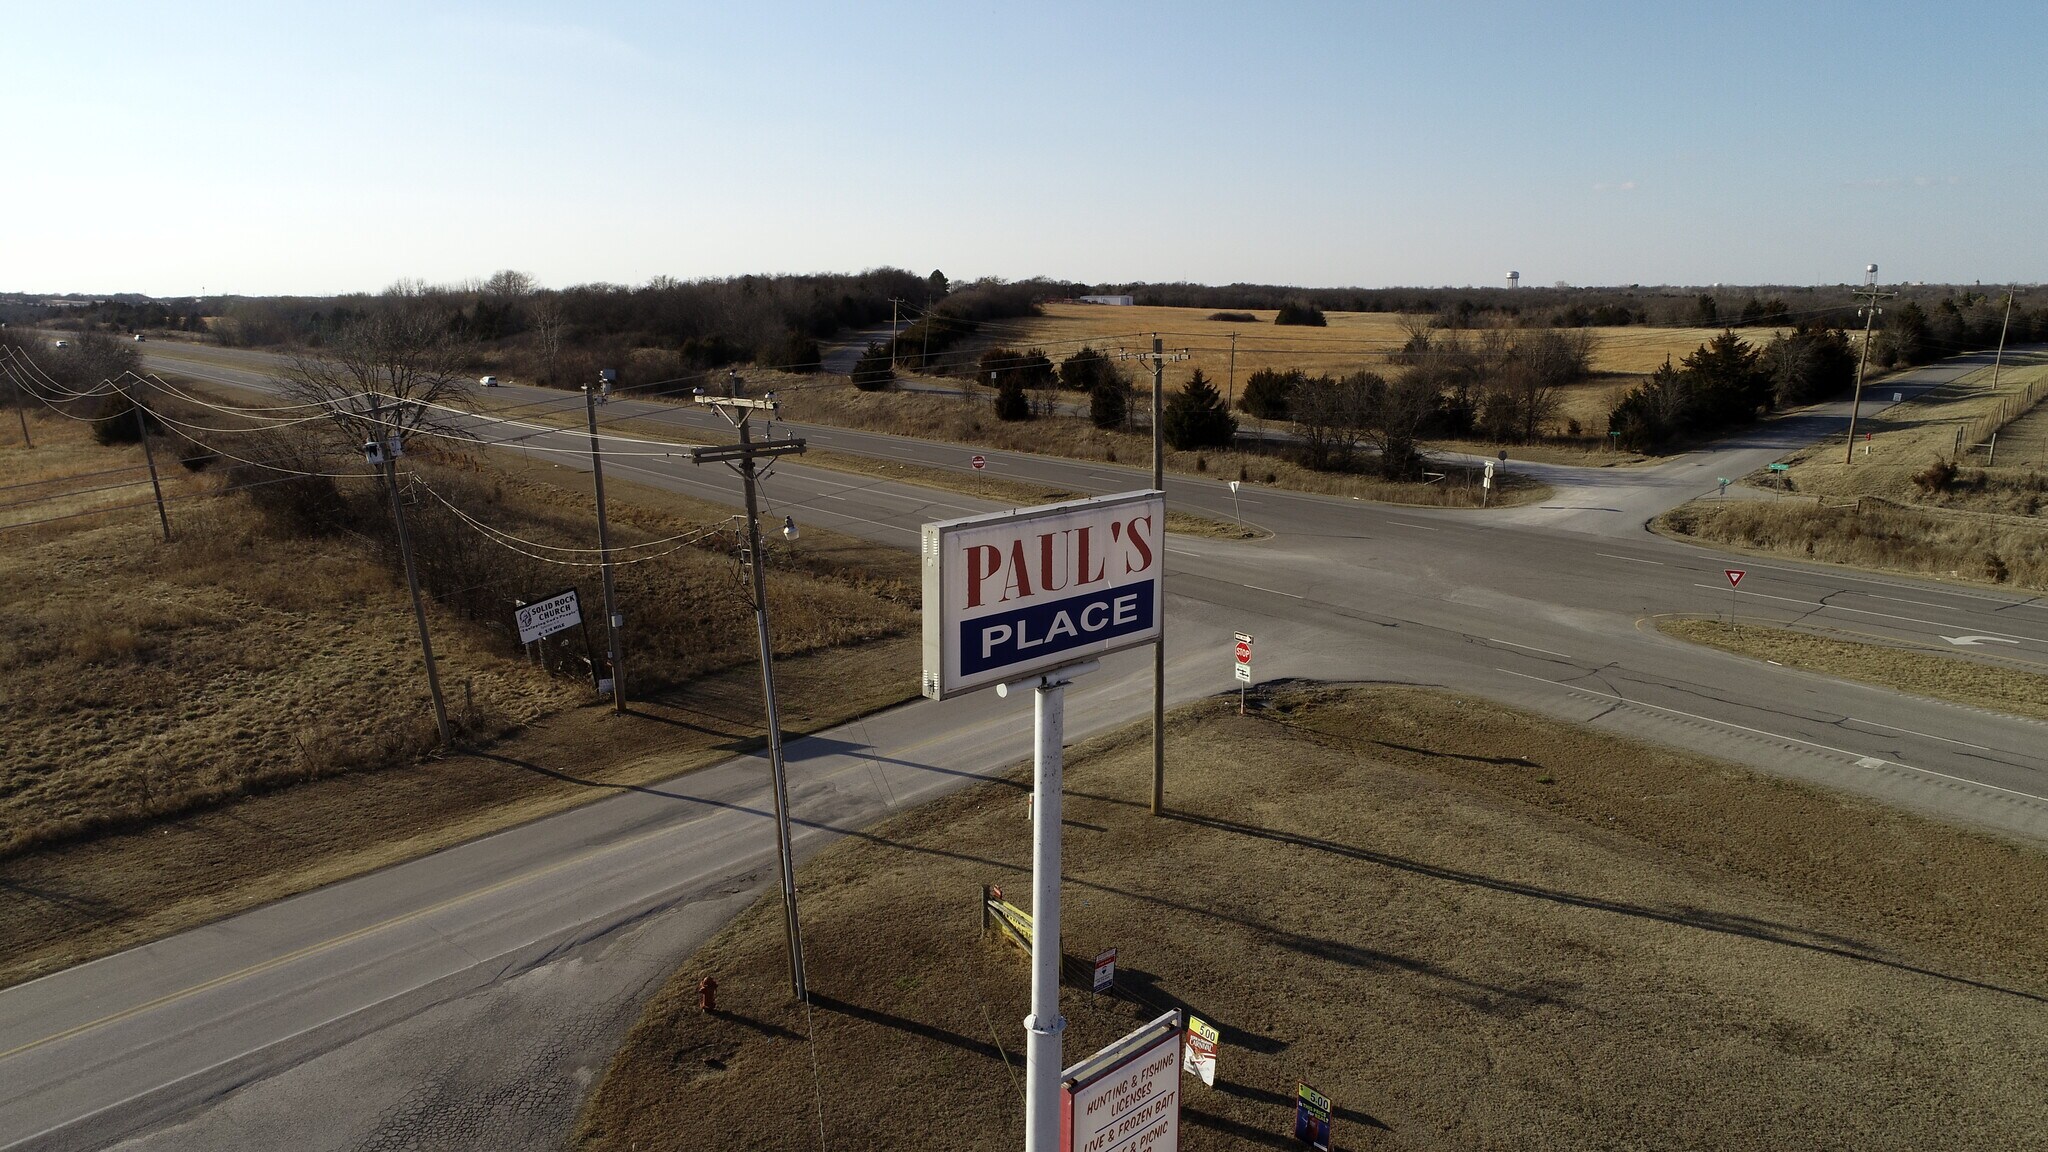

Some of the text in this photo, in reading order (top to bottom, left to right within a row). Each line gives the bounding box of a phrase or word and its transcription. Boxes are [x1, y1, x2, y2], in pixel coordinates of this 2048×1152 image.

[963, 515, 1152, 610] PAUL'S
[532, 595, 575, 615] SOLID ROCK
[538, 604, 571, 621] CHURCH
[982, 593, 1138, 659] PLACE
[1236, 647, 1250, 658] STOP
[1086, 1052, 1174, 1116] HUNTING & FISHING
[1111, 1081, 1152, 1117] LICENSES
[1310, 1092, 1329, 1110] 5.00
[1108, 1128, 1115, 1142] &
[1118, 1105, 1153, 1137] FROZEN
[1155, 1091, 1175, 1114] BAIT
[1130, 1120, 1168, 1152] & PICNIC
